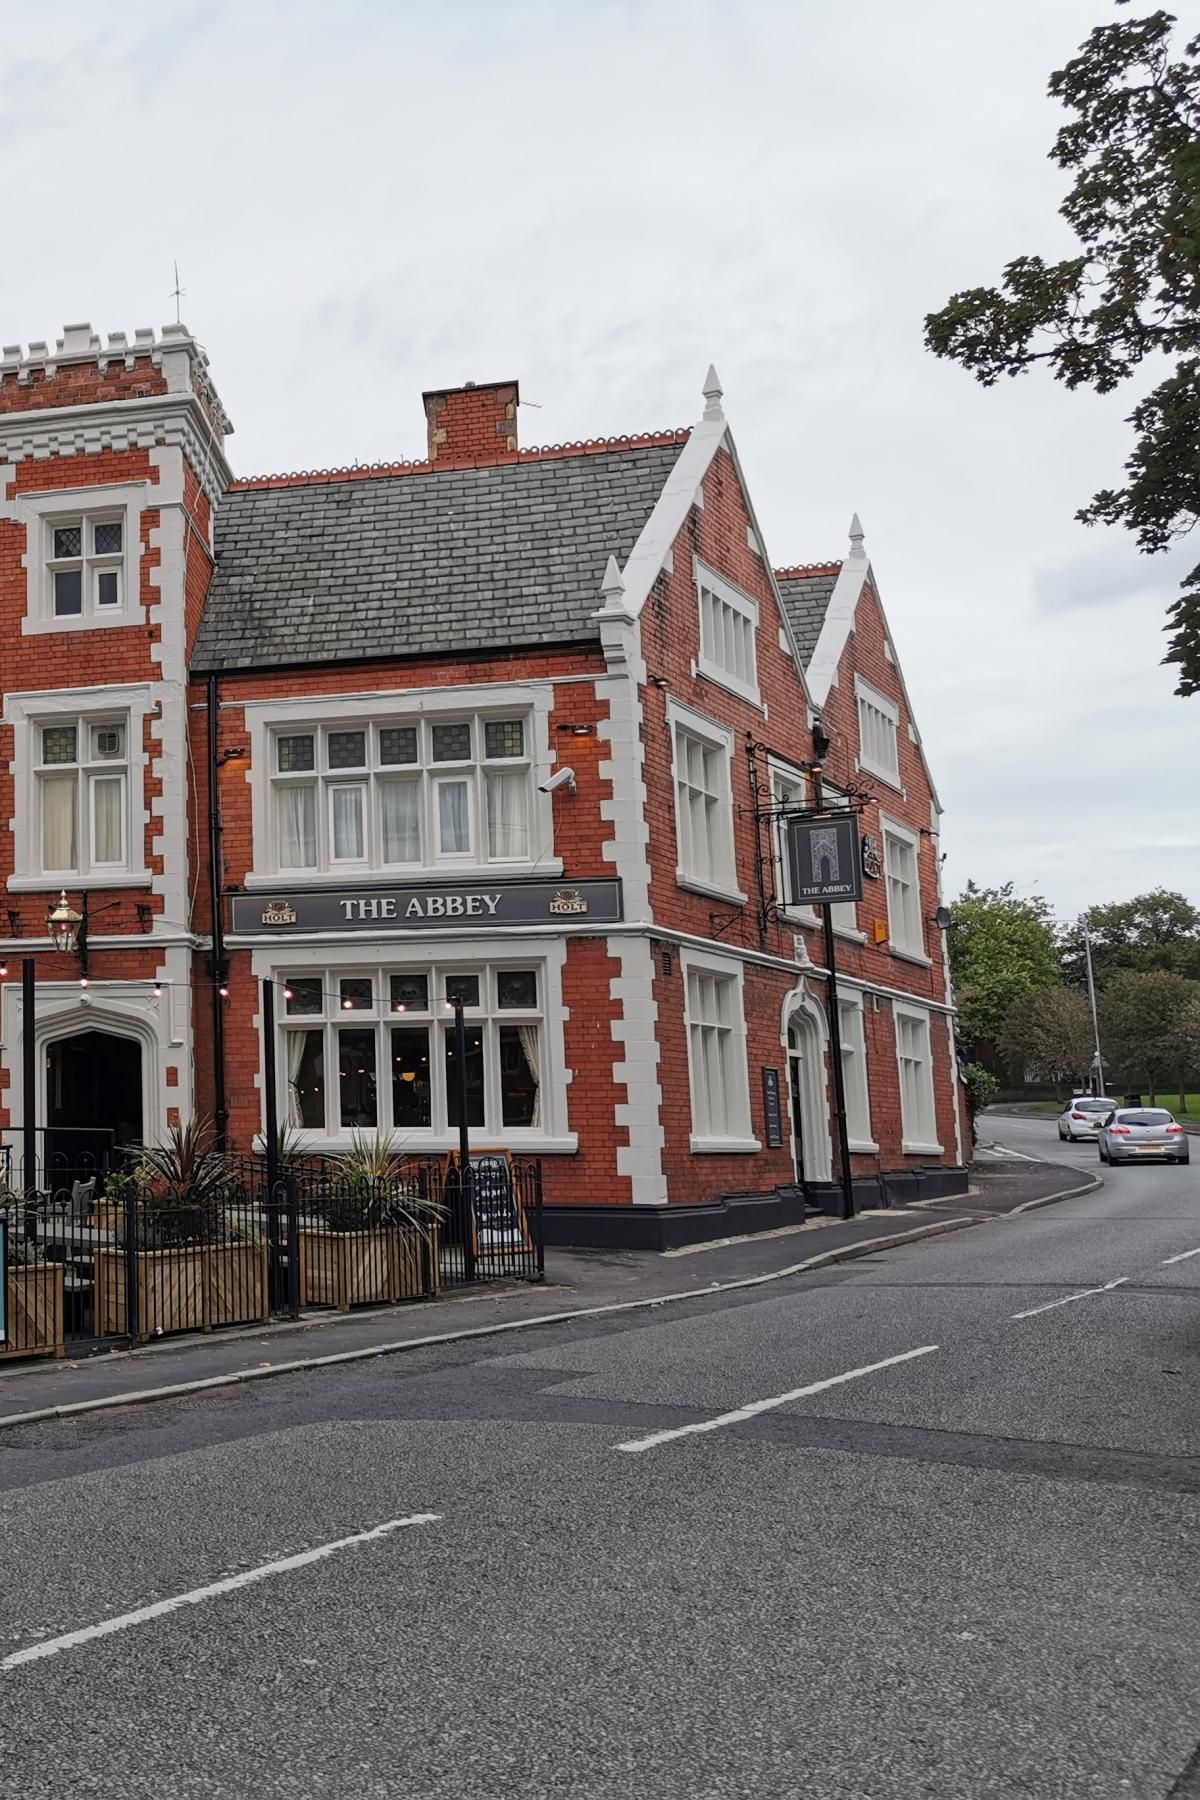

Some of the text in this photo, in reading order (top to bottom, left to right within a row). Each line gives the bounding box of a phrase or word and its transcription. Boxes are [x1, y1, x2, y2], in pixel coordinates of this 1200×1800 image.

[802, 884, 852, 895] THE ABBEY
[340, 894, 502, 920] THE ABBEY
[552, 902, 584, 911] HOLT
[264, 913, 294, 922] HOLT
